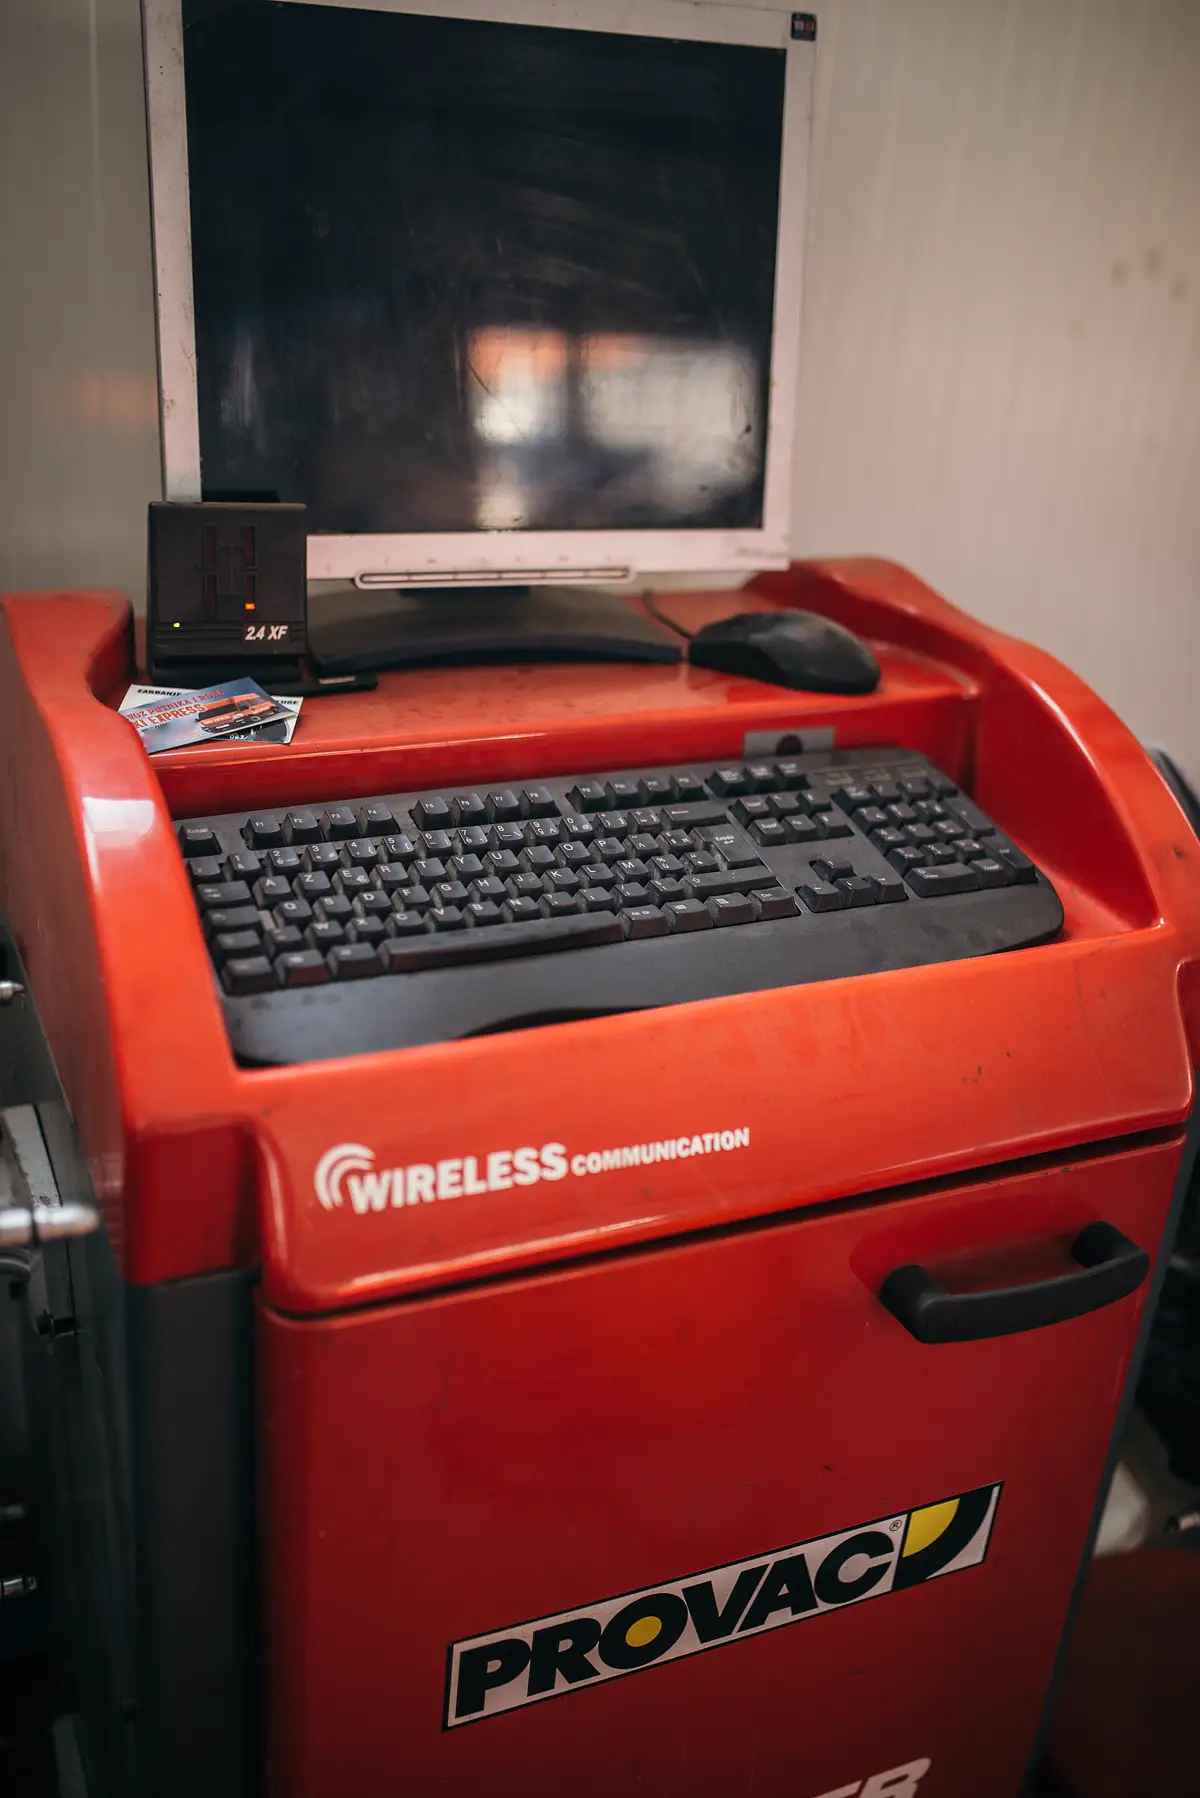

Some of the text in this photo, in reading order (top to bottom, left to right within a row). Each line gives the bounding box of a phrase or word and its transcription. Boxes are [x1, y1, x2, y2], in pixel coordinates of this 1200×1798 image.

[245, 625, 288, 640] 2.4 XF
[147, 703, 208, 726] EXPRESS
[491, 852, 502, 860] U
[418, 860, 427, 868] T
[621, 861, 635, 869] M
[380, 865, 391, 873] R
[304, 874, 315, 882] Z
[342, 870, 353, 878] E
[551, 870, 562, 878] K
[265, 879, 276, 887] A
[479, 879, 490, 887] H
[363, 893, 375, 901] D
[284, 902, 297, 910] Q
[313, 922, 329, 930] W
[347, 1127, 750, 1215] WIRELESS COMMUNICATION
[454, 1530, 895, 1719] PROVAC
